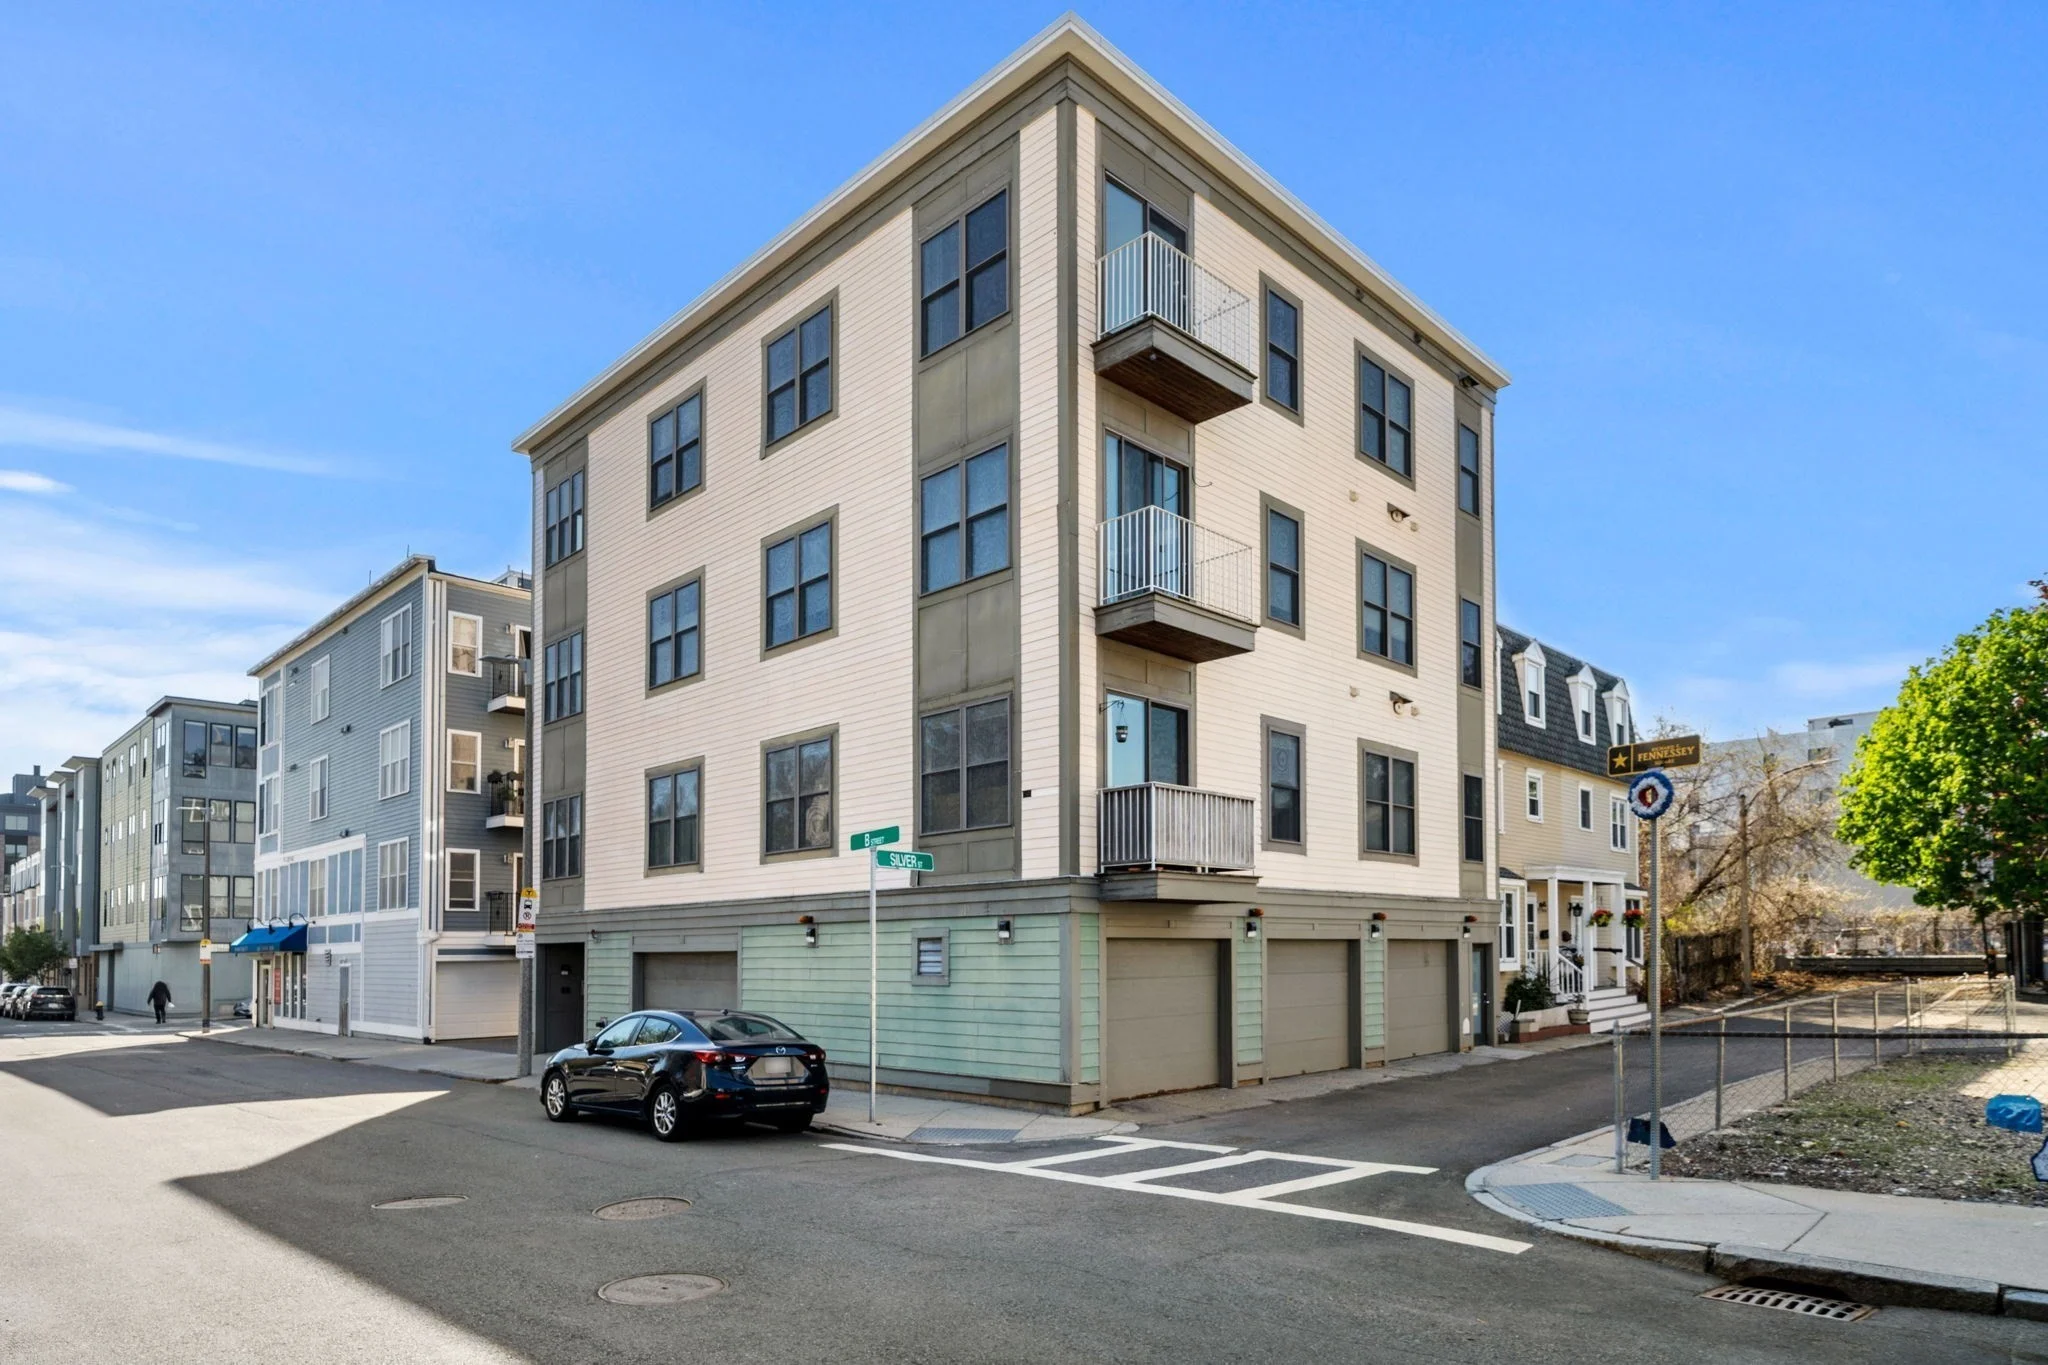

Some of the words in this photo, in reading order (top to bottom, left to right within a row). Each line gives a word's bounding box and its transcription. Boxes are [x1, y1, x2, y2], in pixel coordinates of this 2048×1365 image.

[1637, 745, 1695, 762] FENNESSEY
[864, 833, 870, 847] B
[870, 836, 885, 846] STREET
[890, 853, 917, 868] SILVER
